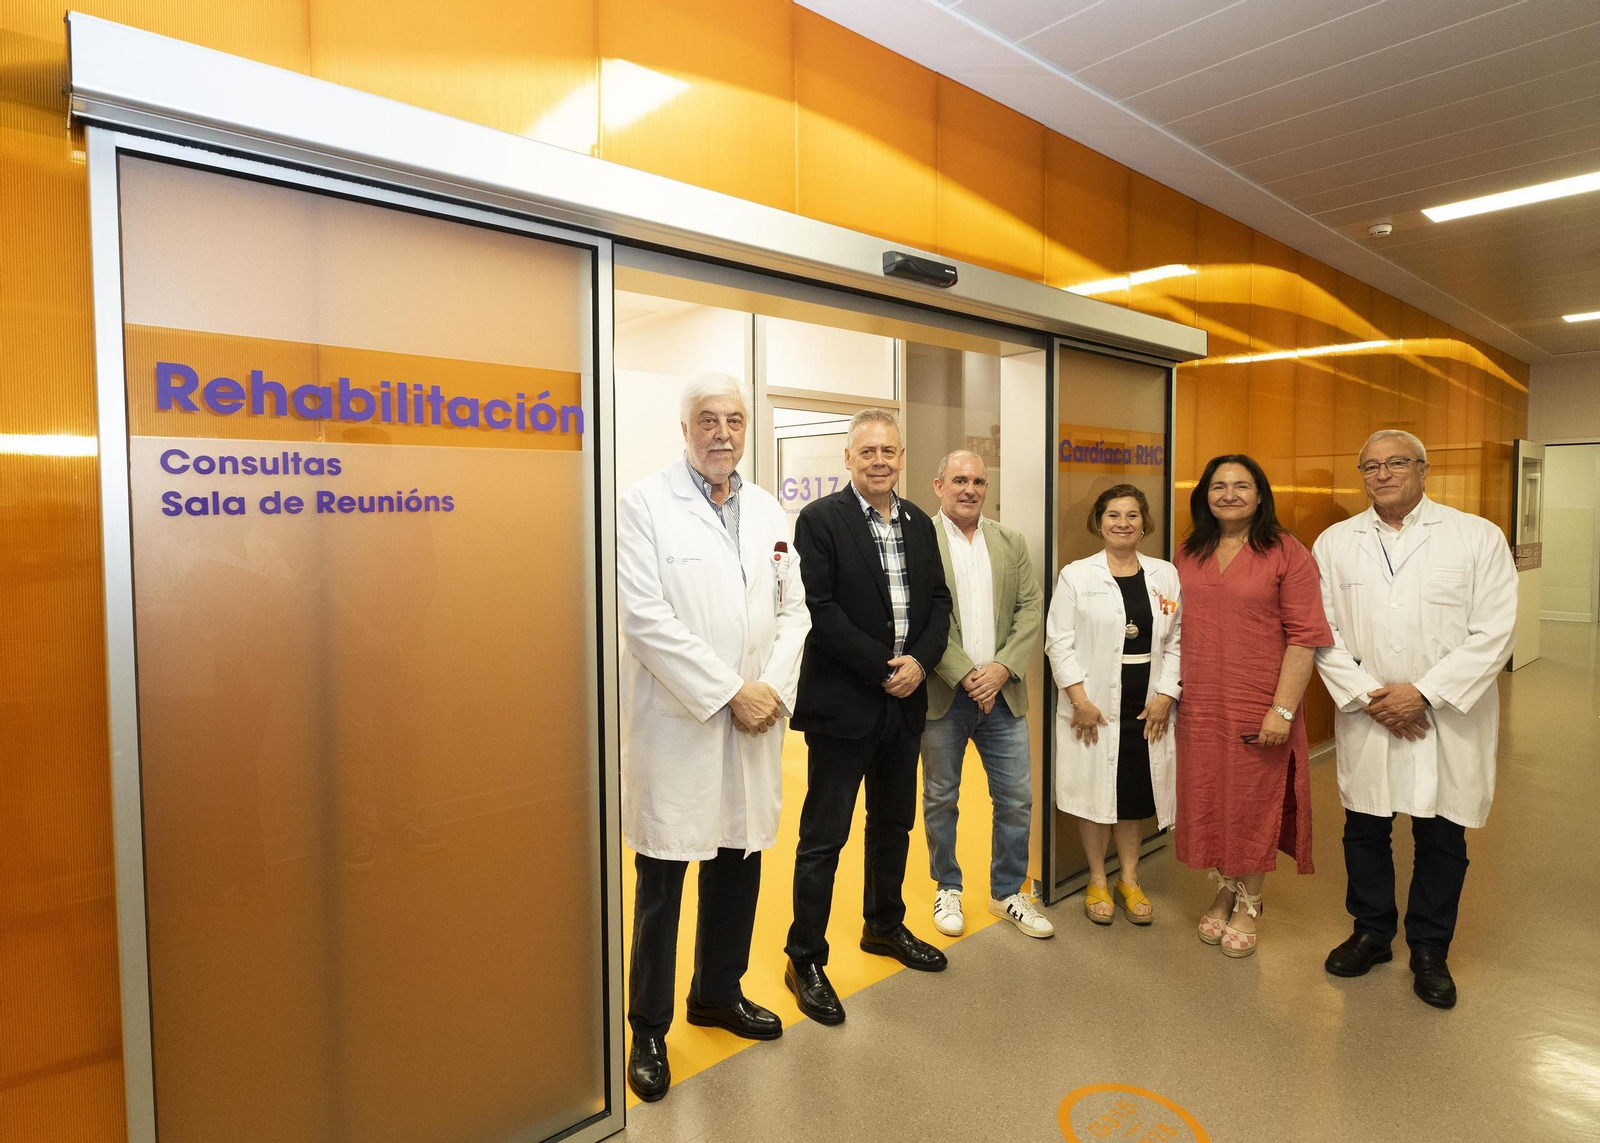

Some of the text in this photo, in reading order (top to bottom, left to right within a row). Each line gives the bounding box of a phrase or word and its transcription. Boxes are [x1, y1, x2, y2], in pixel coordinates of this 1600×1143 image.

[156, 361, 585, 433] Rehabilitación
[159, 448, 342, 476] Consultas
[1060, 439, 1164, 465] Cardíaca RHC
[781, 476, 839, 501] G317
[161, 489, 455, 517] Sala de Reunións
